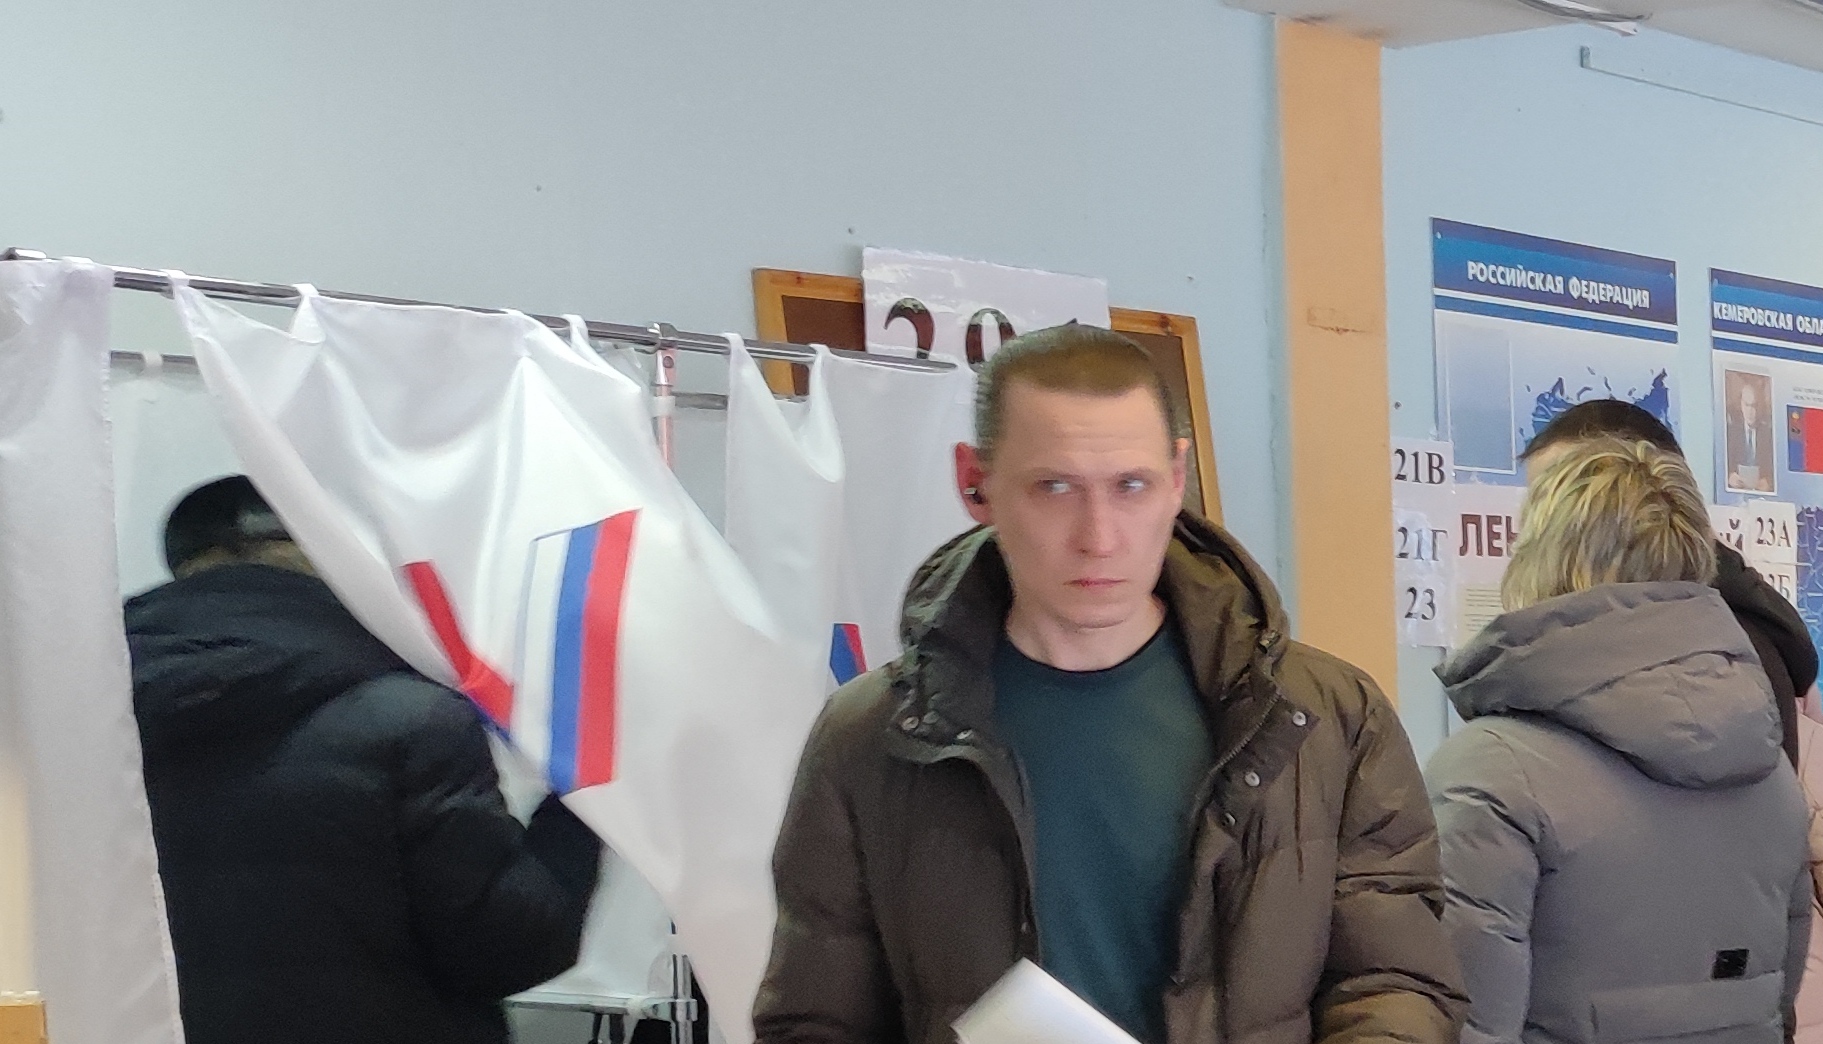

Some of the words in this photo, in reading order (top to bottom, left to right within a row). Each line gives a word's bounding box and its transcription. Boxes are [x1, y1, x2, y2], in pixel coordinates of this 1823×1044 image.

[1467, 261, 1564, 295] РОССИЙСКАЯ
[1568, 276, 1650, 310] ФЕДЕРАЦИЯ
[1713, 301, 1794, 331] КЕМЕРОВСКАЯ
[1394, 448, 1446, 486] 21В
[1395, 526, 1448, 562] 21Г
[1756, 516, 1792, 548] 23А
[1404, 586, 1438, 621] 23
